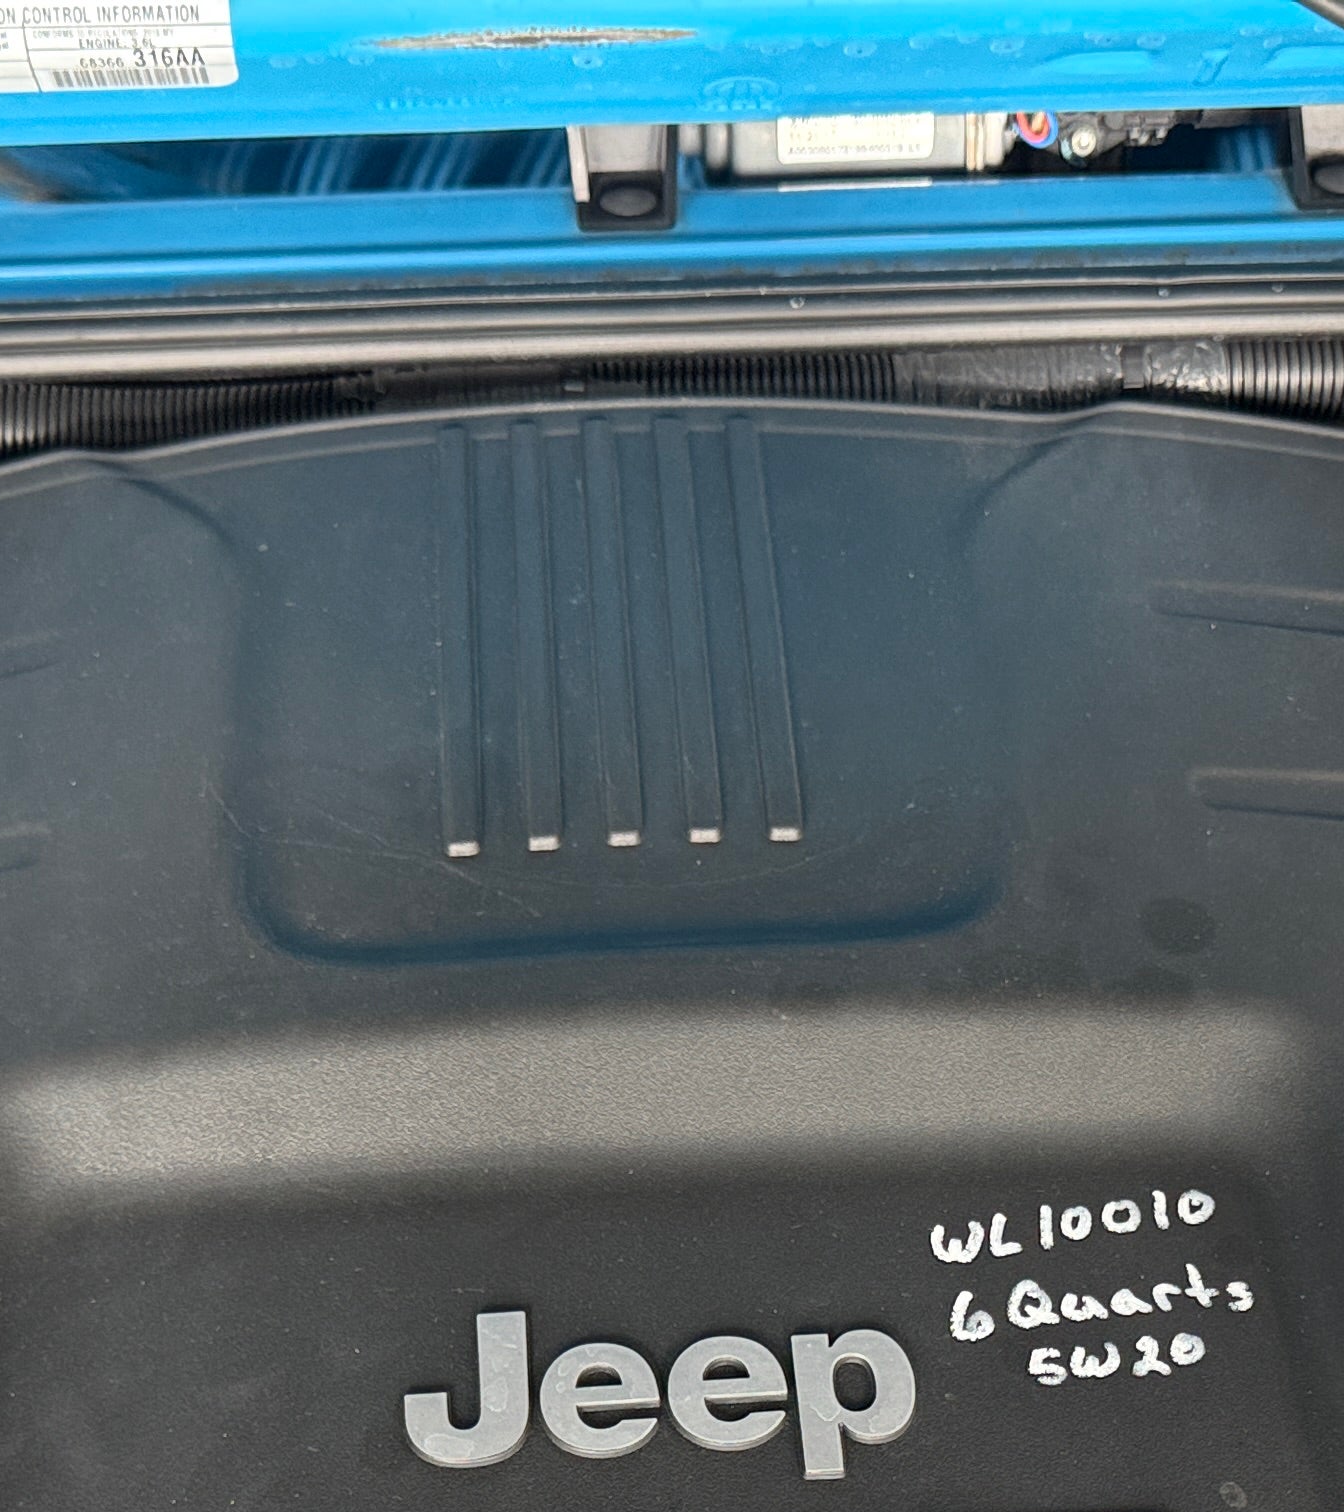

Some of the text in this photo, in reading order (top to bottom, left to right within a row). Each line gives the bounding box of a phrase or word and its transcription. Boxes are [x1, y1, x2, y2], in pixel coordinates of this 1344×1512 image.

[23, 6, 91, 24] CONTROL
[97, 5, 200, 22] INFORMATION
[133, 47, 206, 68] 316AA
[950, 1263, 1254, 1342] 6 Quarts
[1028, 1332, 1206, 1386] 5W20
[404, 1310, 917, 1480] Jeep
